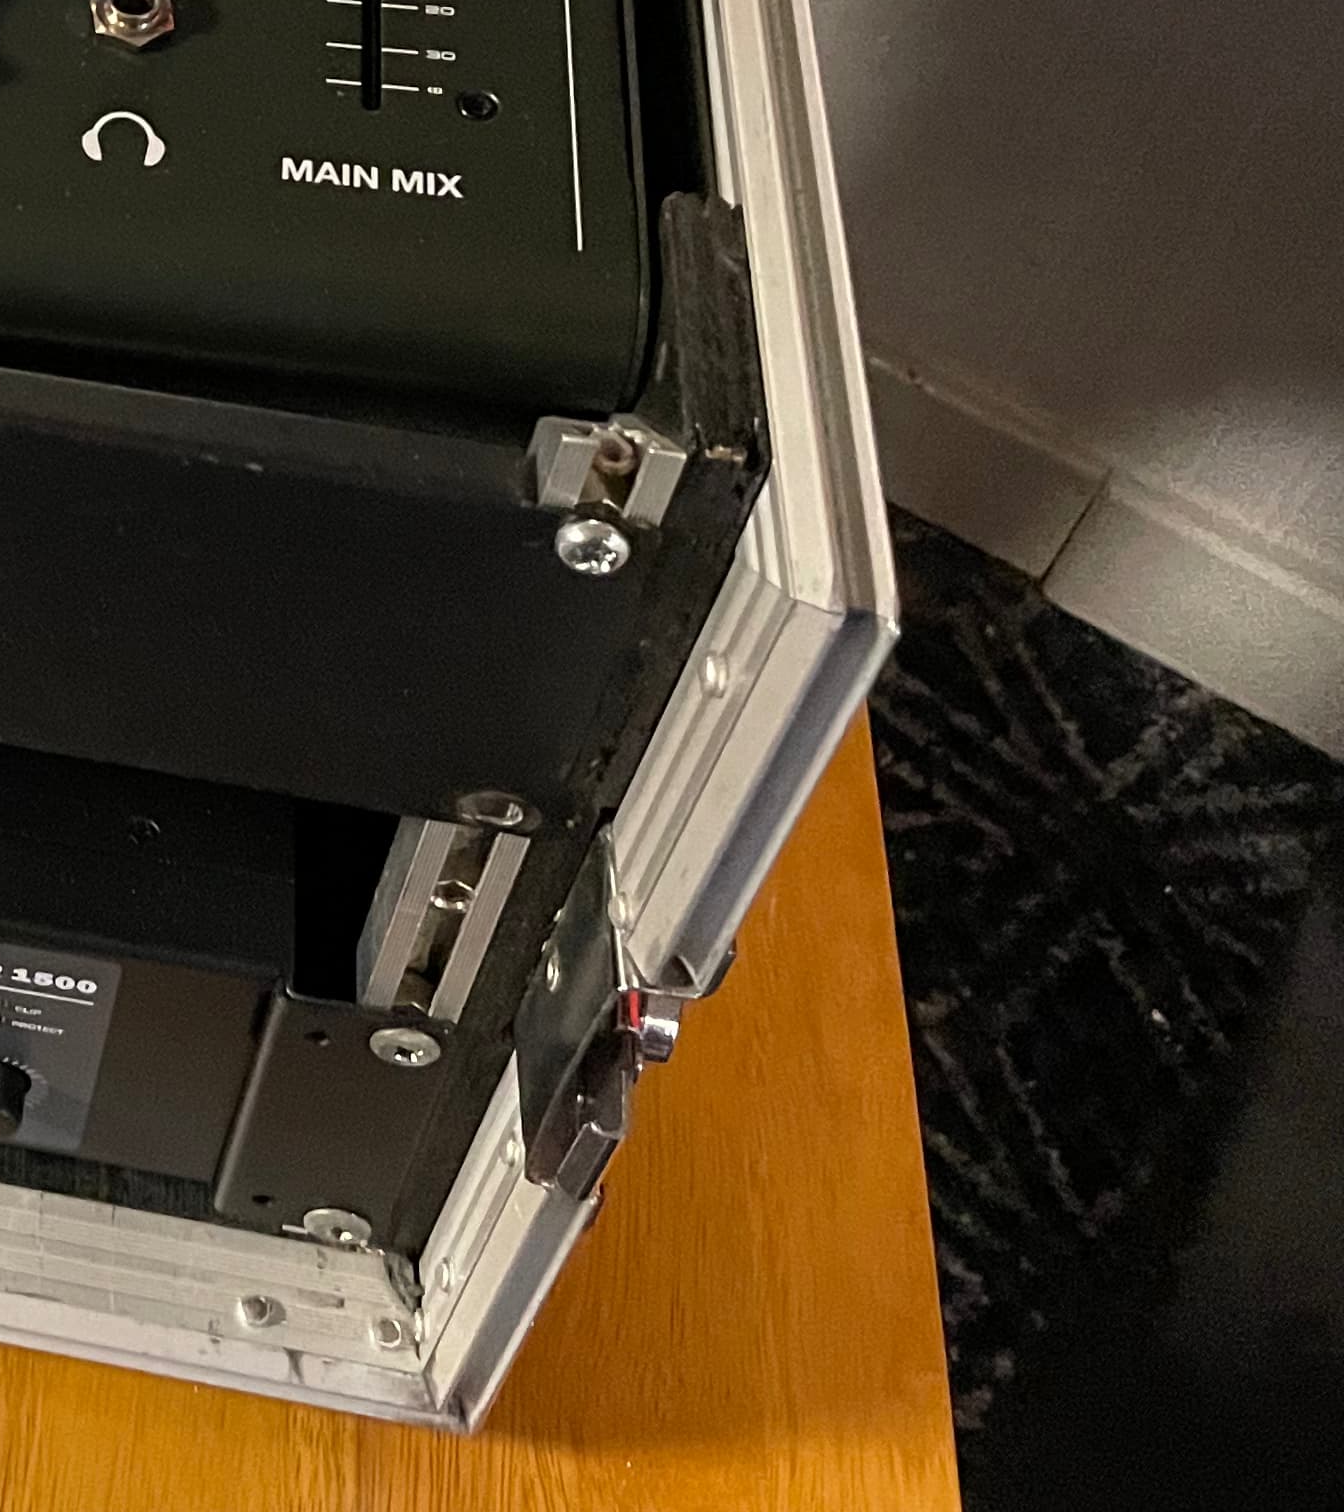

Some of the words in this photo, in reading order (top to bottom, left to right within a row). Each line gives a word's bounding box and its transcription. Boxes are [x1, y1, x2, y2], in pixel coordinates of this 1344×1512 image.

[280, 156, 379, 190] MAIN
[391, 168, 464, 199] MIX
[10, 967, 98, 994] 1500
